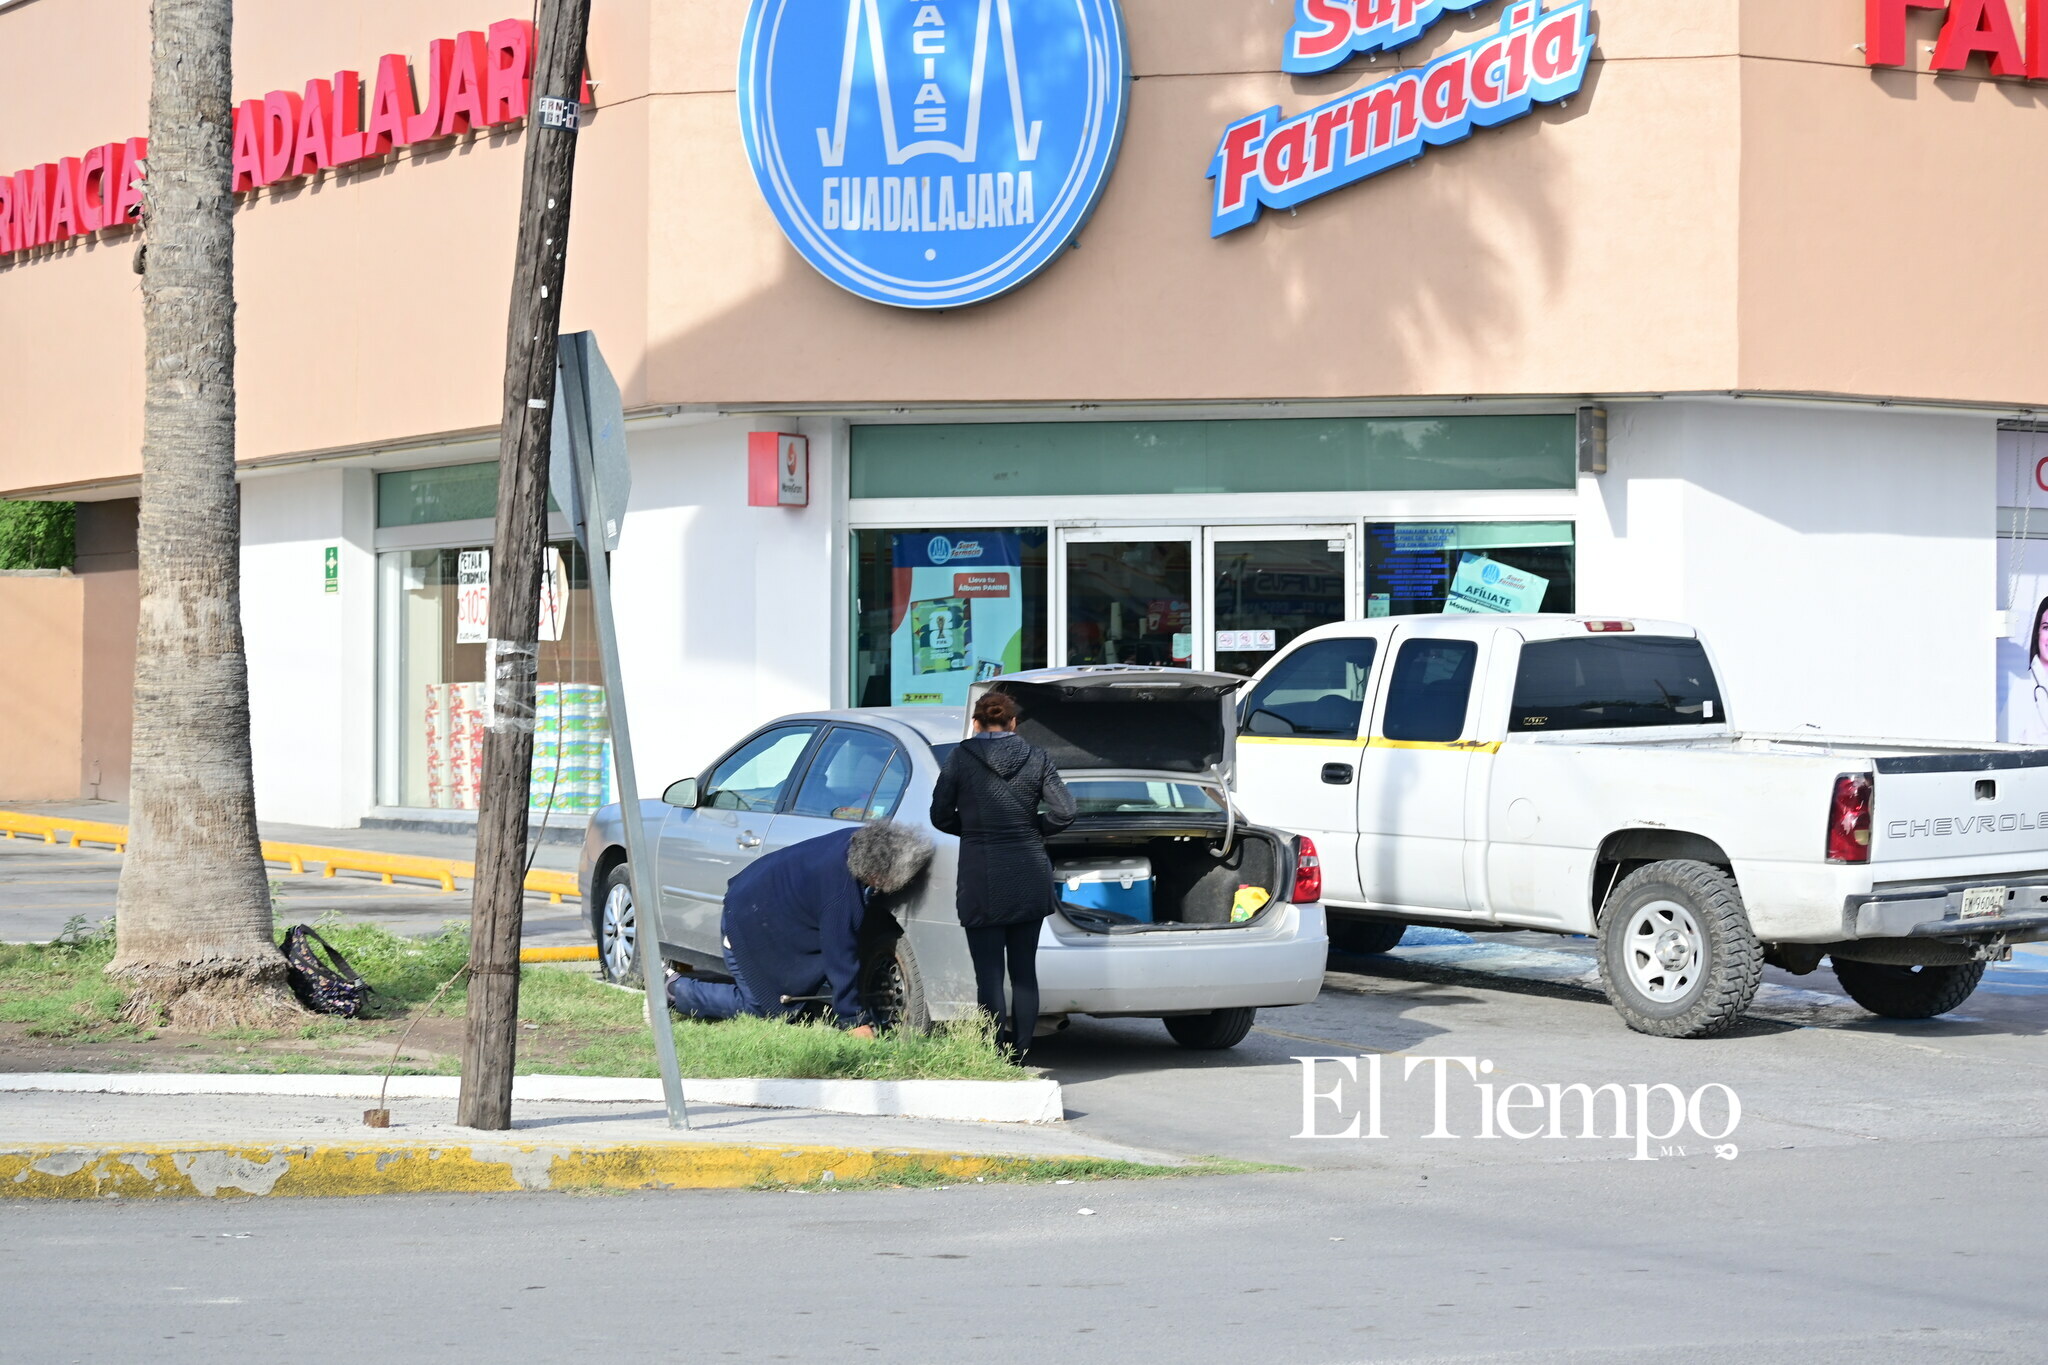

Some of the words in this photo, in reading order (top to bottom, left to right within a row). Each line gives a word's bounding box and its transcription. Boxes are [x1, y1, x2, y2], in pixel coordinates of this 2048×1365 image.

[1221, 6, 1580, 209] Farmacia
[822, 171, 1035, 232] GUADALAJARA
[1465, 585, 1512, 607] AFÍLIATE
[1888, 811, 2048, 839] CHEVROLE
